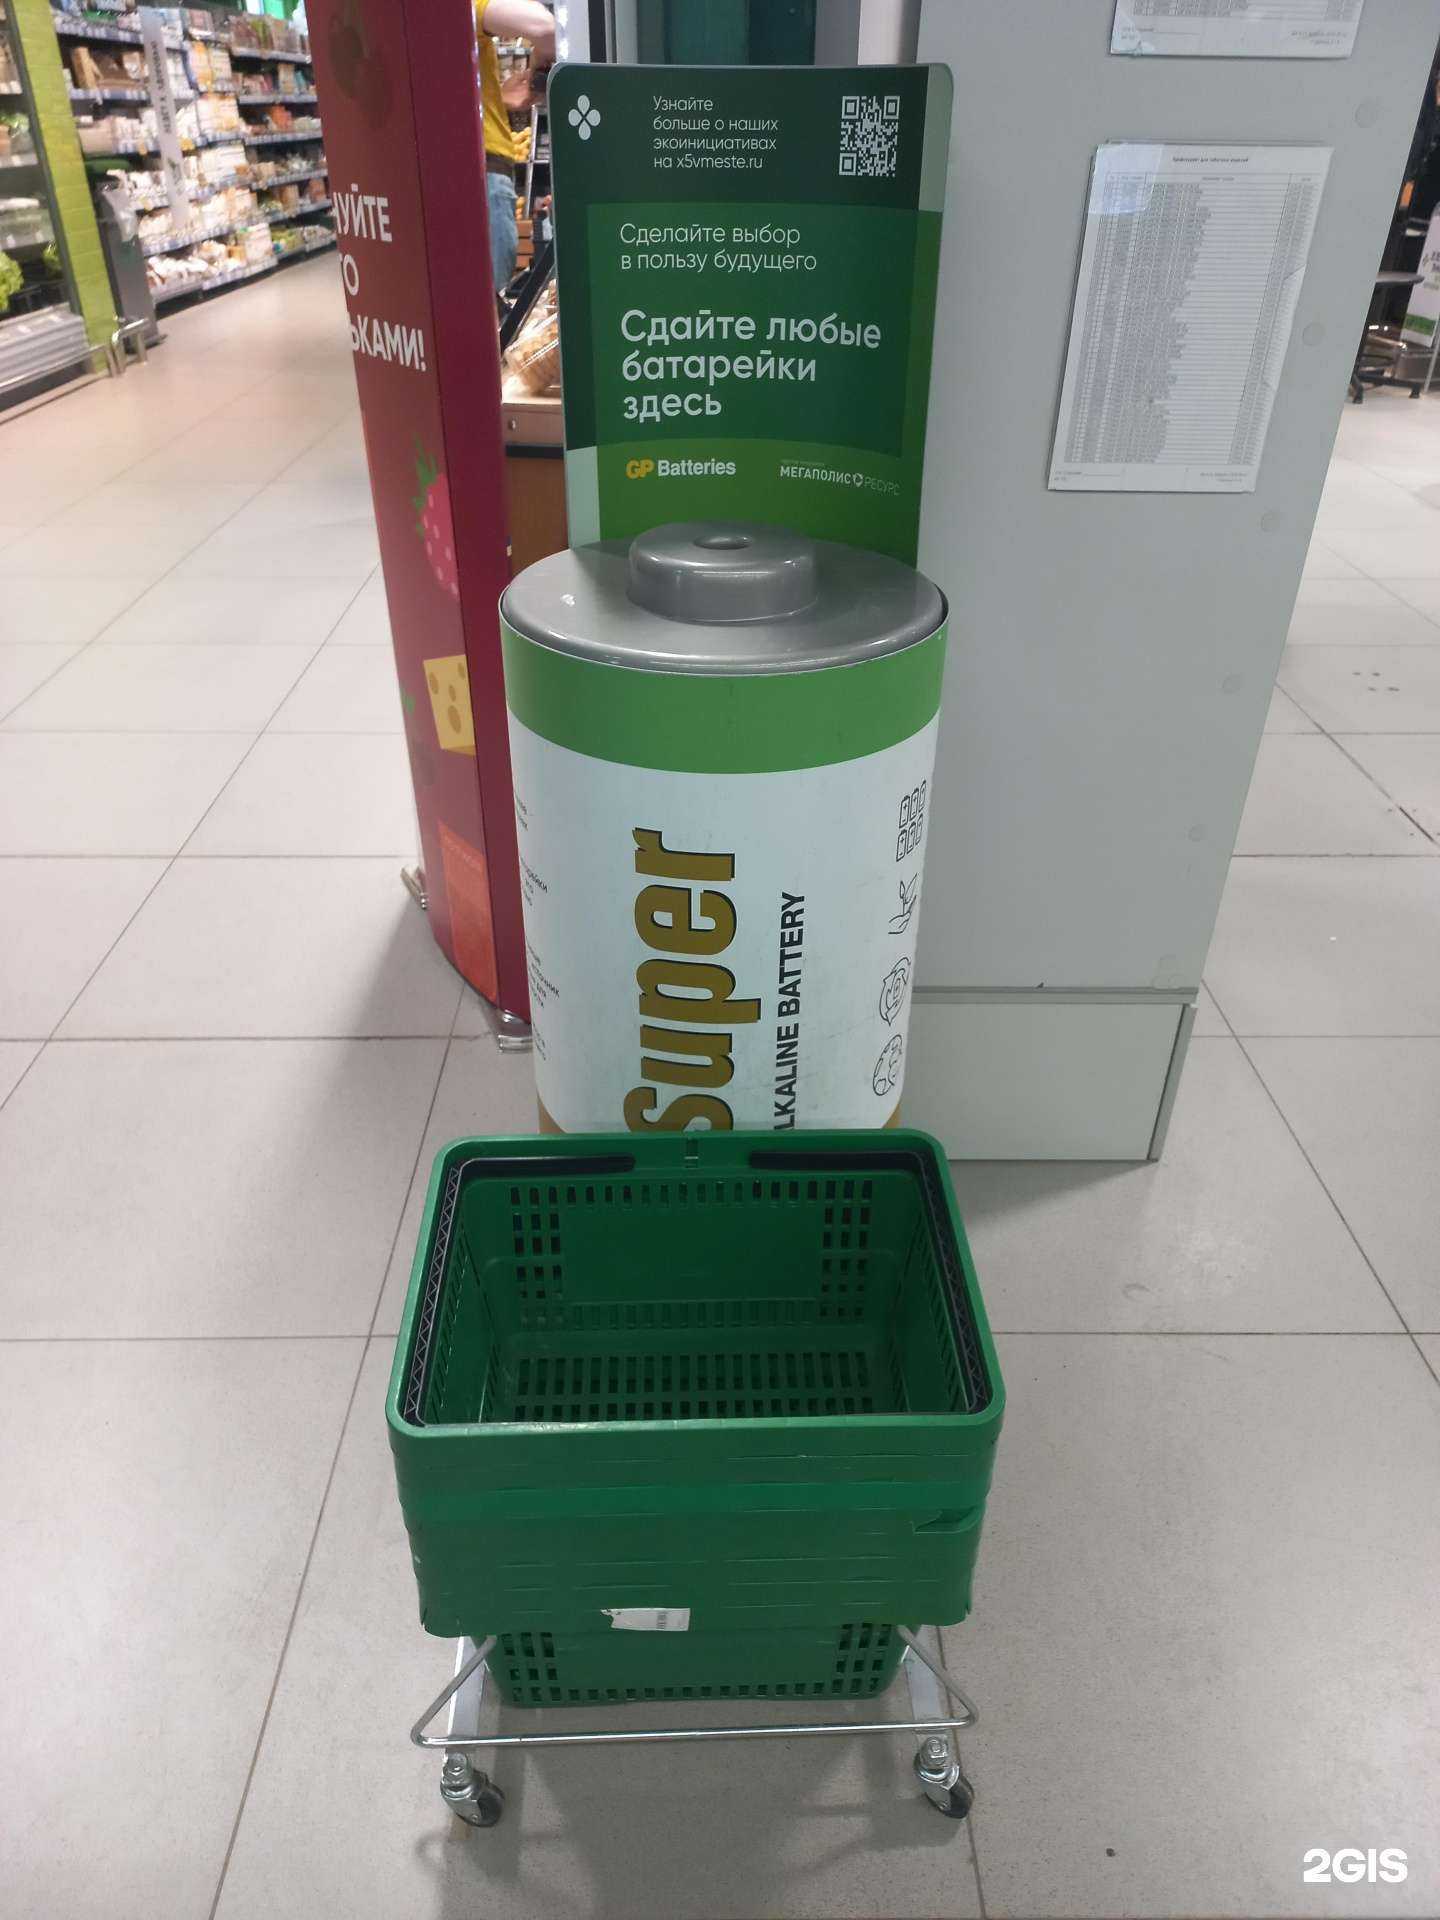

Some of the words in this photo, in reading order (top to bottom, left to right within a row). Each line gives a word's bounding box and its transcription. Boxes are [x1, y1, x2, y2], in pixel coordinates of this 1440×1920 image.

[653, 95, 713, 111] Узнайте
[653, 116, 711, 131] больше
[714, 119, 725, 131] о
[729, 119, 778, 131] наших
[653, 138, 777, 151] экоинициативах
[654, 157, 673, 169] на
[677, 153, 763, 169] x5vmeste.ru
[620, 223, 726, 247] Сделайте
[732, 224, 800, 248] выбор
[621, 254, 632, 270] в
[637, 253, 708, 273] пользу
[714, 249, 817, 273] будущего
[338, 253, 360, 296] О
[621, 309, 756, 346] Сдайте
[766, 312, 881, 349] любые
[622, 349, 816, 386] батарейки
[623, 393, 722, 423] здесь
[625, 458, 654, 479] GP
[657, 458, 737, 477] Batteries
[780, 465, 851, 485] МЕГАПОЛИС
[778, 892, 805, 1018] BATTERY
[623, 827, 761, 1132] Super
[774, 1022, 799, 1131] LKALINE
